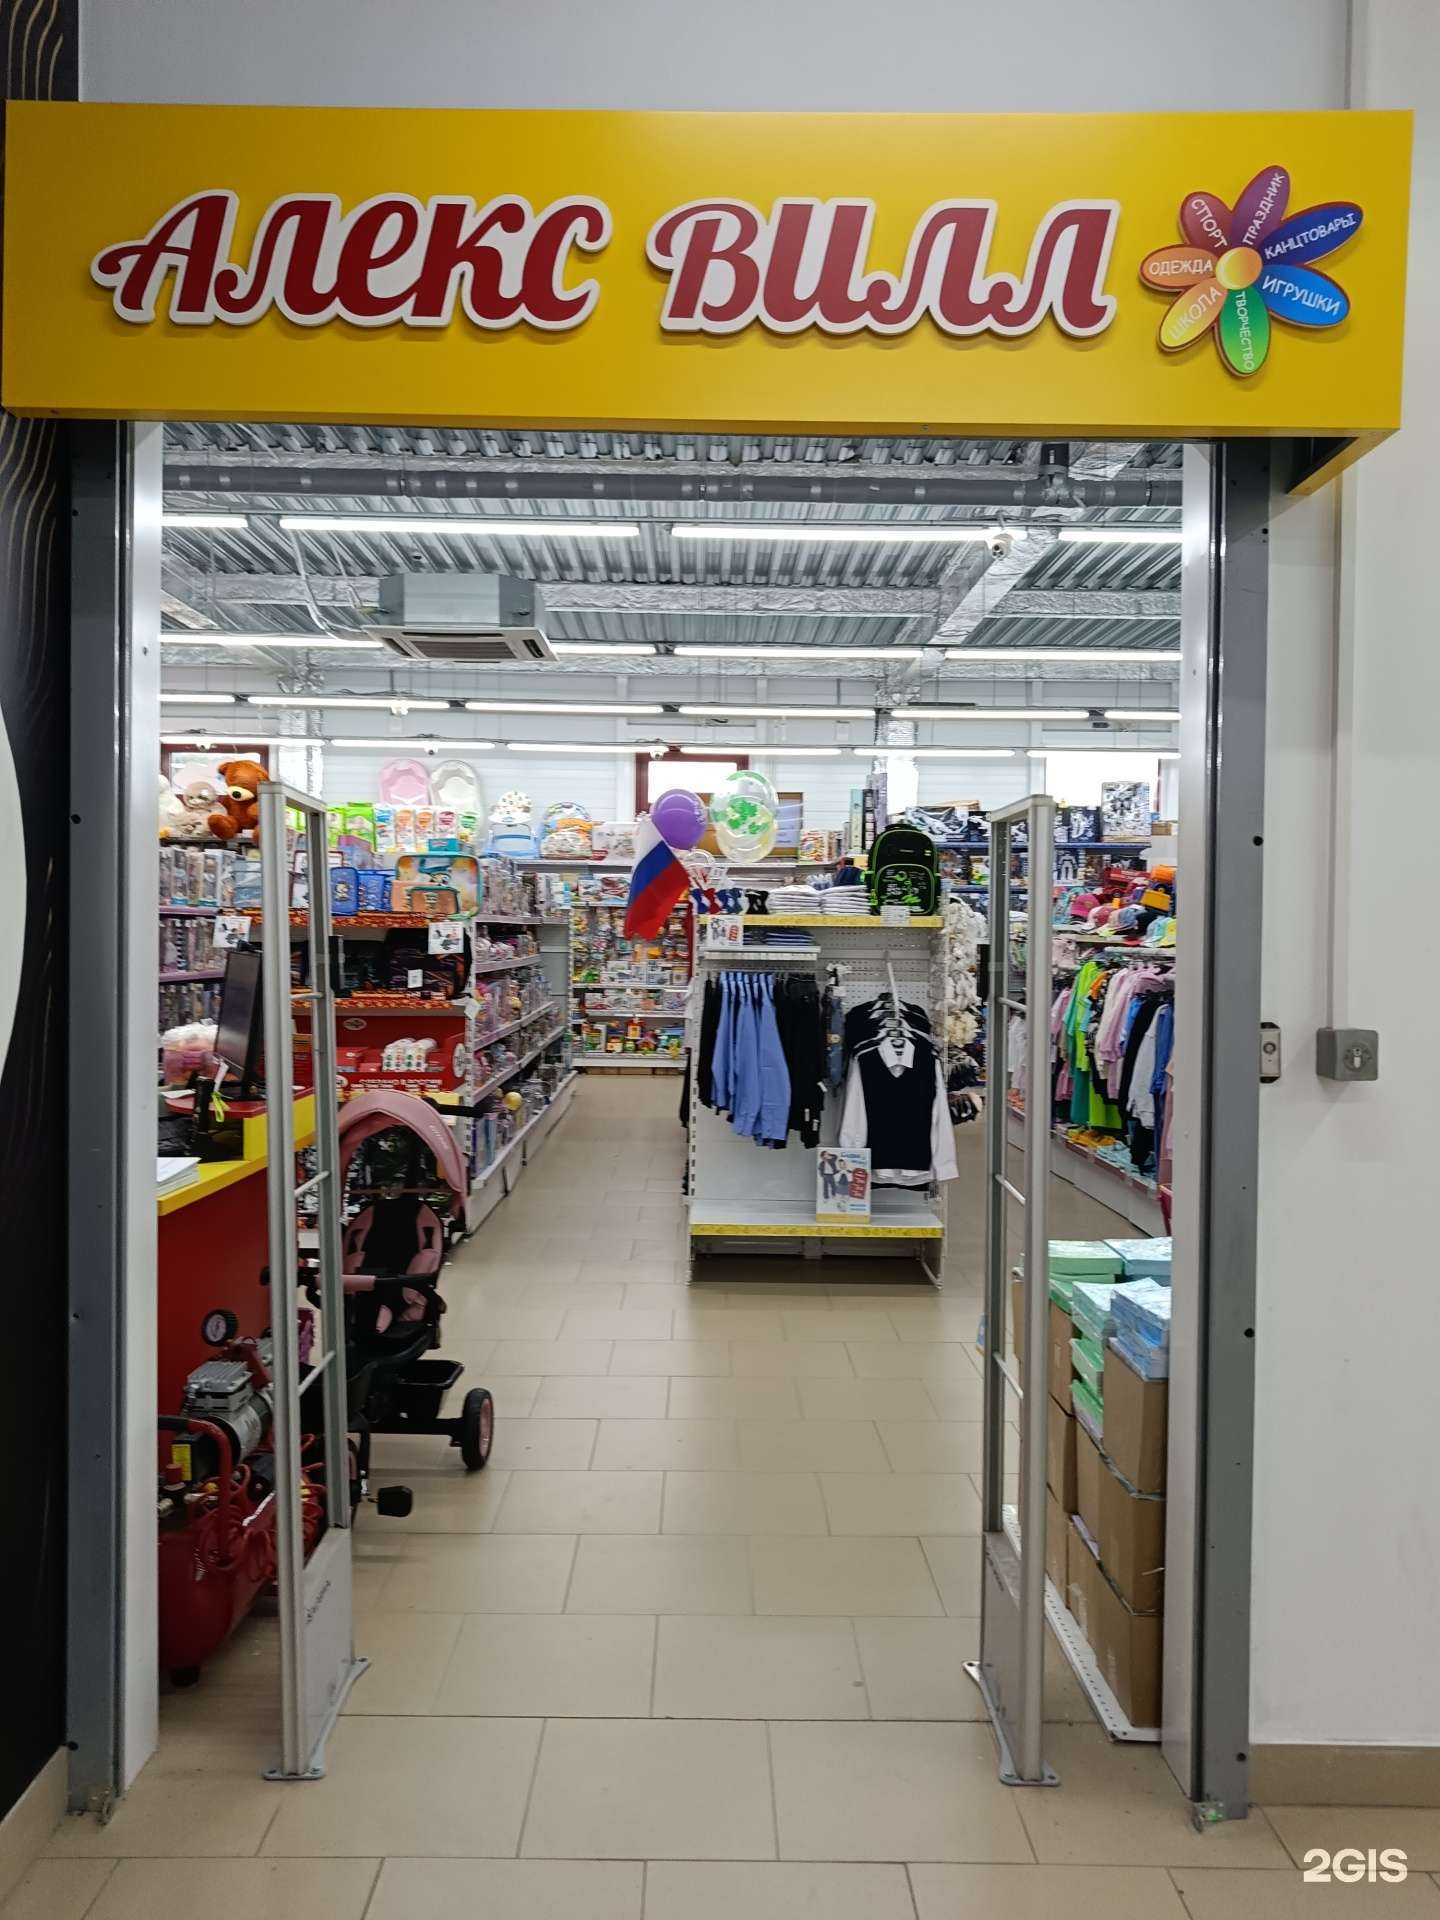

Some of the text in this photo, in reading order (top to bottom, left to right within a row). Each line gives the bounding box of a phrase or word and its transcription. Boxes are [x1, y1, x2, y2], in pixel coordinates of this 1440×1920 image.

[1191, 198, 1228, 249] СПОРТ
[1242, 172, 1286, 247] ПРАЗДНИК
[1264, 212, 1358, 260] КАНЦТОВАРЫ
[1149, 259, 1214, 276] ОДЕЖДА
[1169, 286, 1222, 340] ШКОЛА
[1262, 275, 1341, 316] ИГРУШКИ
[1237, 291, 1255, 371] ТВОРЧЕСТВО
